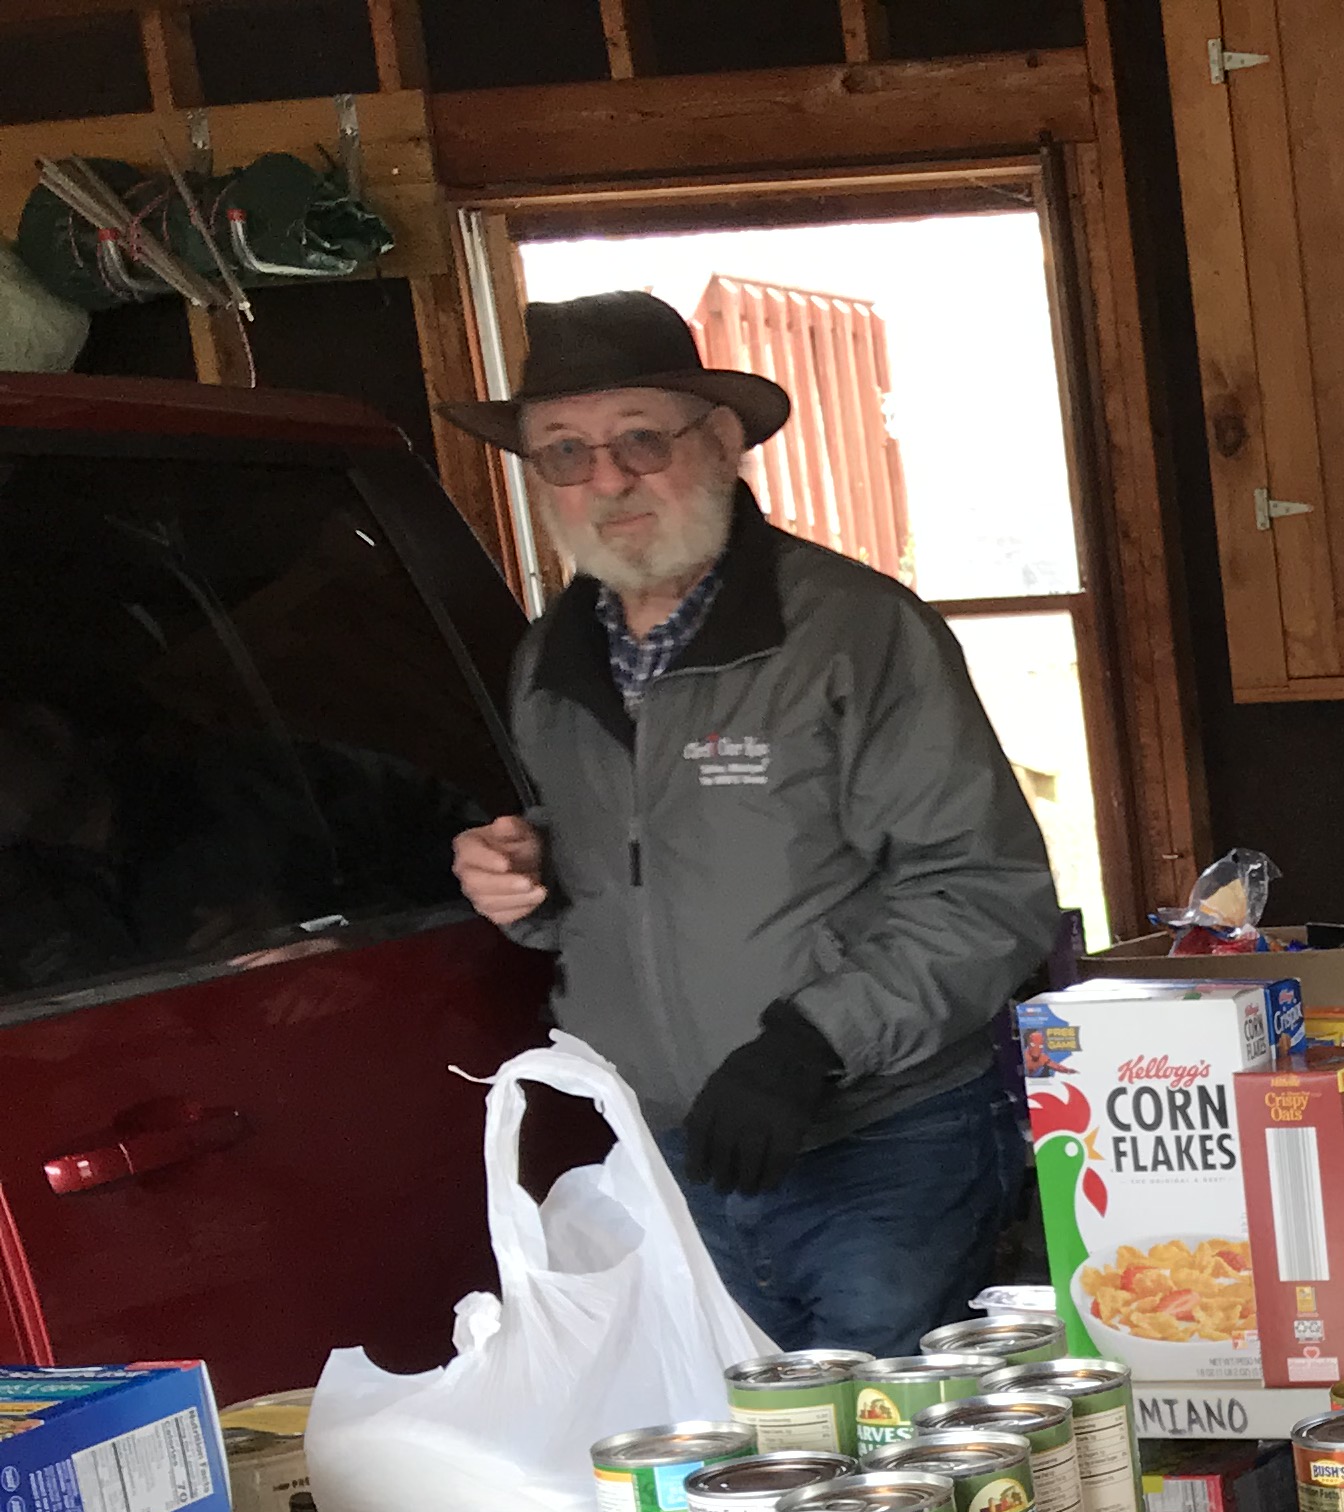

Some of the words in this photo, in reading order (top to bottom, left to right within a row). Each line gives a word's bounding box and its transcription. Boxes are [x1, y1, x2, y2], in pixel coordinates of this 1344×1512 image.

[1117, 1055, 1212, 1087] Kellogg's
[1106, 1084, 1230, 1132] CORN
[1265, 1092, 1309, 1110] Crispy
[1271, 1108, 1303, 1121] Oats
[1112, 1133, 1236, 1173] FLAKES
[1135, 1398, 1248, 1434] MIANO
